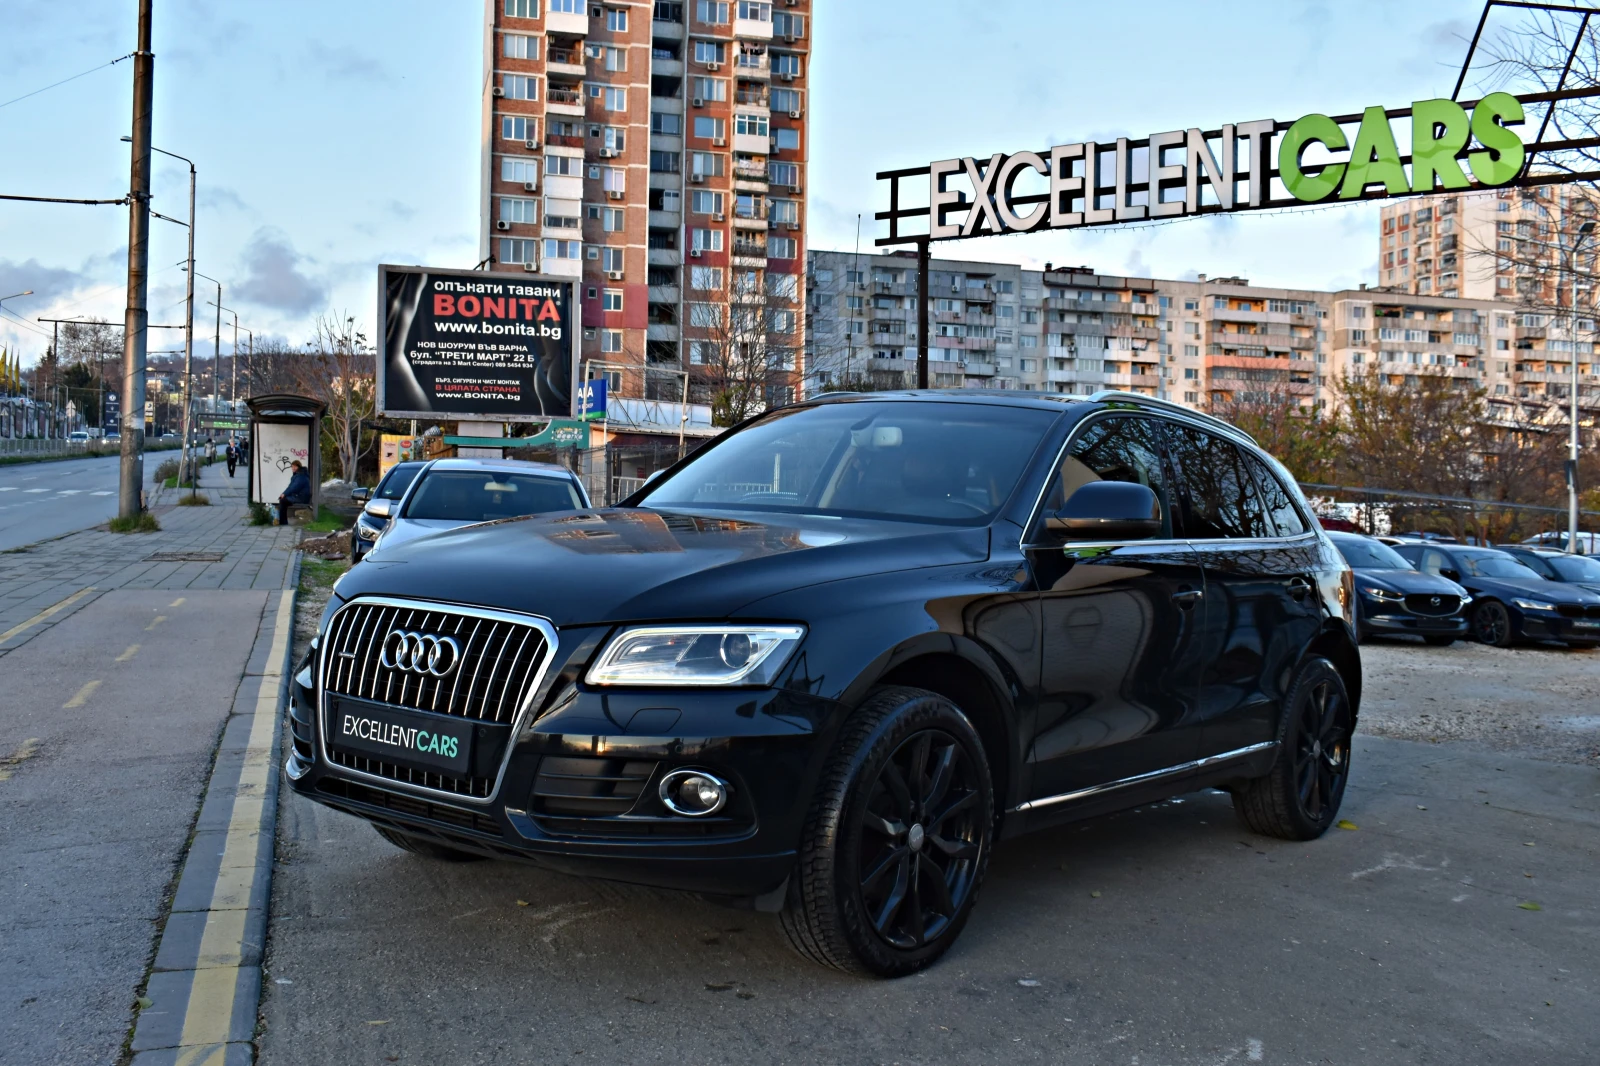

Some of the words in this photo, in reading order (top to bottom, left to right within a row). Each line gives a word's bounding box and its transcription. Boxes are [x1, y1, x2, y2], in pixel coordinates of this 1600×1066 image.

[434, 281, 503, 295] опънати
[507, 285, 561, 298] тавани
[433, 293, 561, 321] BONITA
[434, 321, 562, 340] www.bonita.bg
[438, 342, 476, 350] ШОУРУМ
[478, 343, 497, 351] ВЪВ
[499, 344, 528, 352] ВАРНА
[410, 350, 432, 360] бул.
[513, 354, 525, 362] 22
[436, 392, 521, 401] www.BONITA.bg
